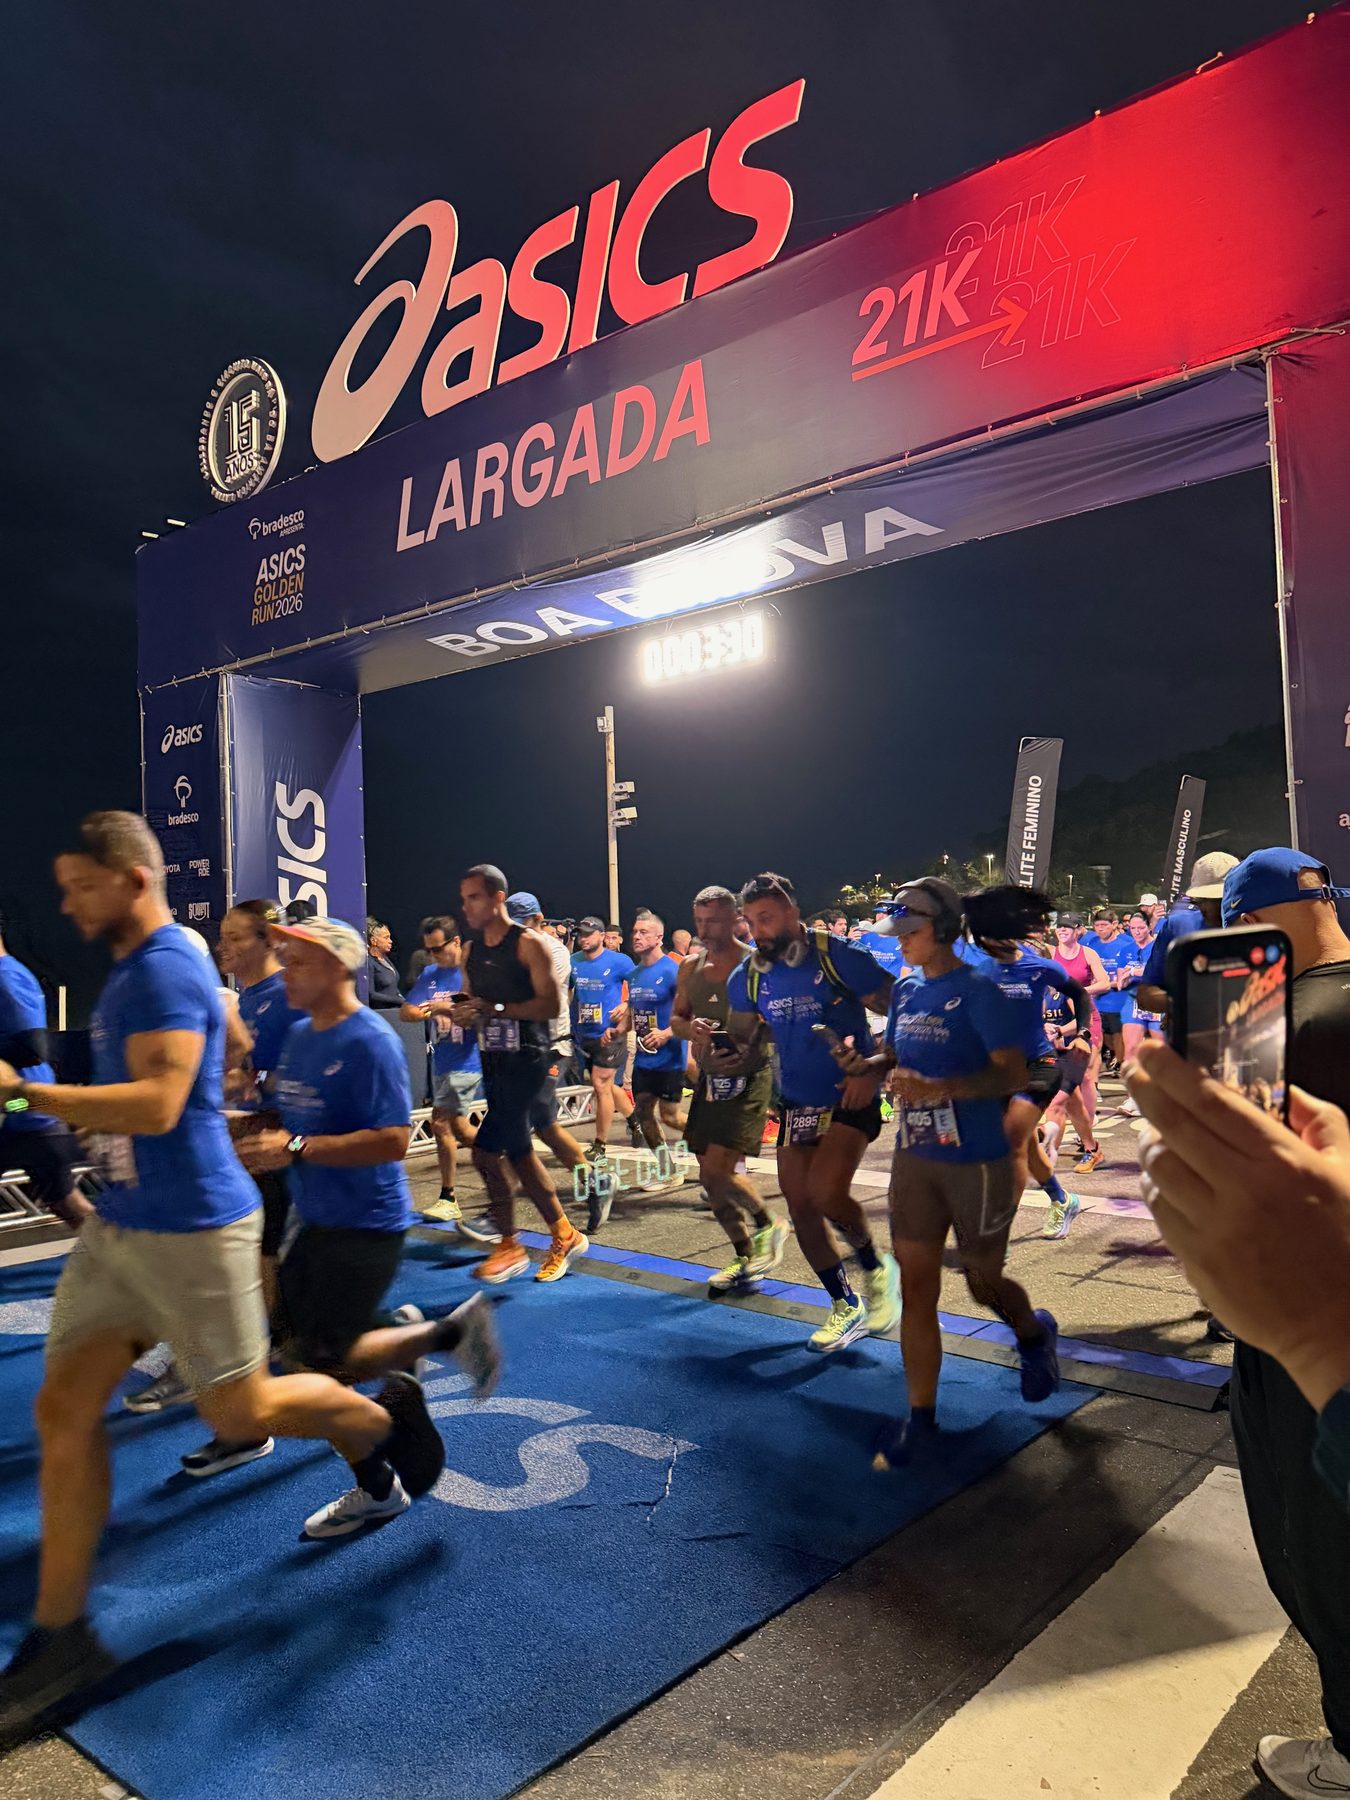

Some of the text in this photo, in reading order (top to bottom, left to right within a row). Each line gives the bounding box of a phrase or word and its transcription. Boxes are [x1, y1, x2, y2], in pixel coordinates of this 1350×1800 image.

[421, 79, 805, 417] asics
[851, 247, 983, 366] 21K
[224, 389, 260, 463] 15
[224, 452, 259, 483] ANOS
[396, 359, 711, 553] LARGADA
[262, 509, 305, 537] bradesco
[256, 543, 306, 586] ASICS
[253, 572, 305, 607] GOLDEN
[426, 606, 614, 657] BOA
[174, 724, 203, 747] asics
[168, 812, 199, 826] bradesco
[1019, 775, 1043, 889] LITE FEMININO
[275, 780, 328, 919] SICS
[1173, 809, 1192, 875] MASCULINO
[160, 864, 181, 874] OYOTA
[189, 859, 210, 870] POWER
[792, 1115, 819, 1129] 2895
